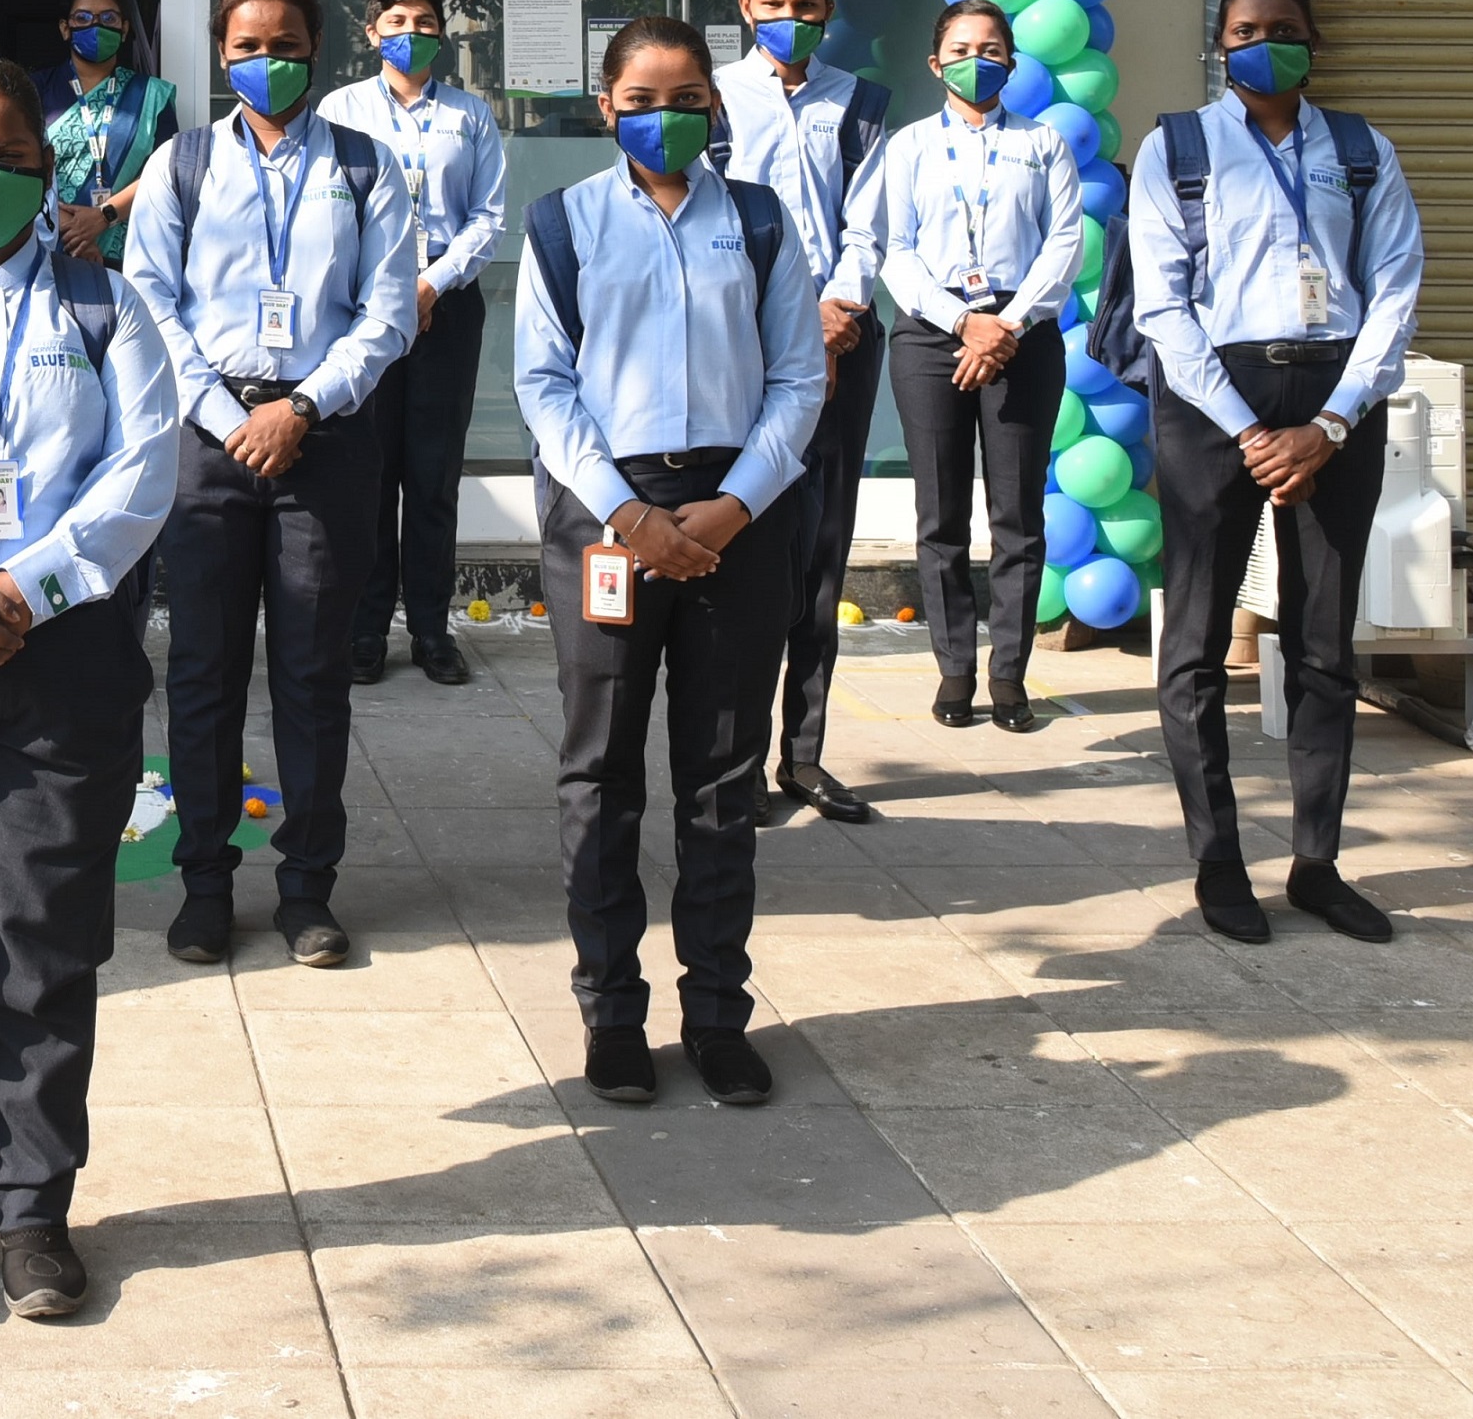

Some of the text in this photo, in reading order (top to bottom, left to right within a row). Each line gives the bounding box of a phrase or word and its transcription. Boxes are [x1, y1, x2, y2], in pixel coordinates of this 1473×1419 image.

[813, 125, 834, 134] BLUE
[1309, 173, 1334, 185] BLUE
[303, 191, 327, 202] BLUE
[712, 240, 742, 251] BLUE
[31, 353, 65, 367] BLUE
